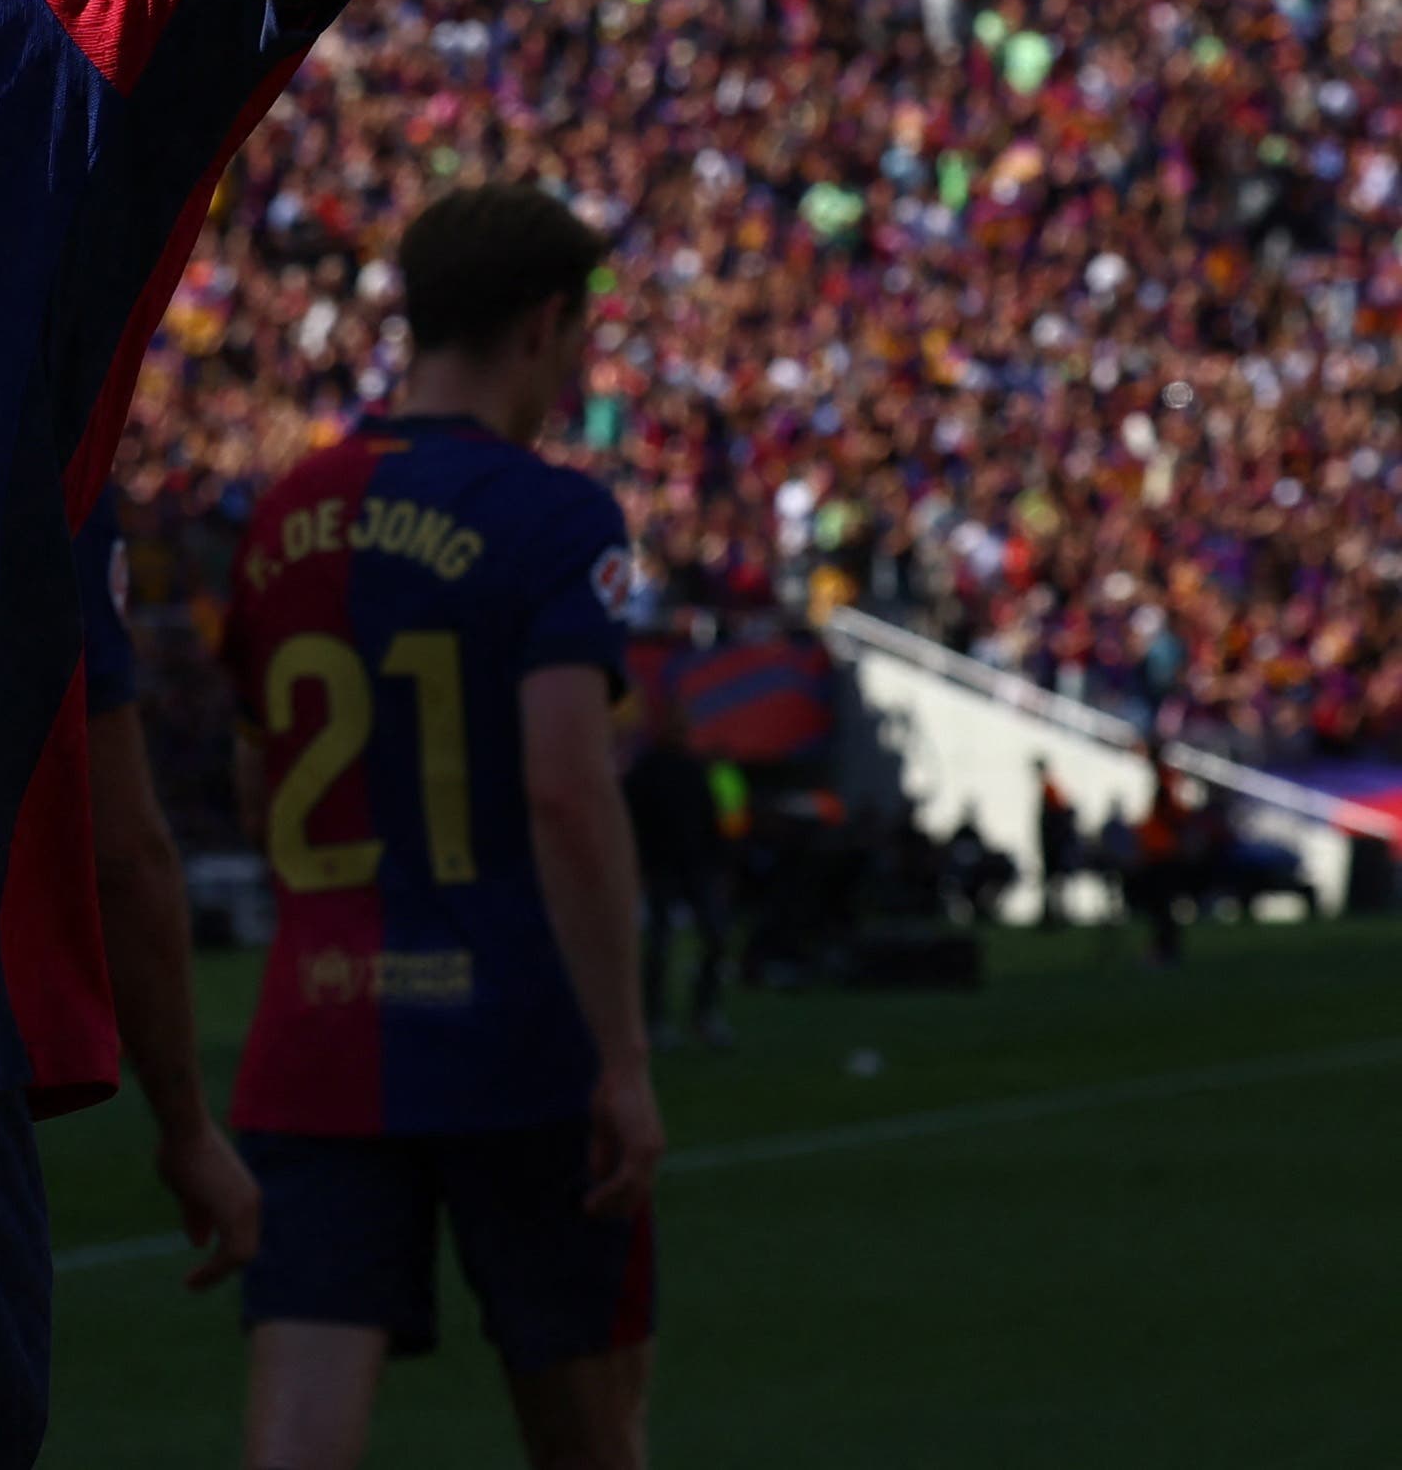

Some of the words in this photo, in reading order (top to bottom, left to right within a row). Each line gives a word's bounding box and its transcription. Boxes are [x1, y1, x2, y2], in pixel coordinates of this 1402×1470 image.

[280, 496, 346, 563] DE
[347, 496, 485, 582] JONG
[262, 630, 479, 894] 21
